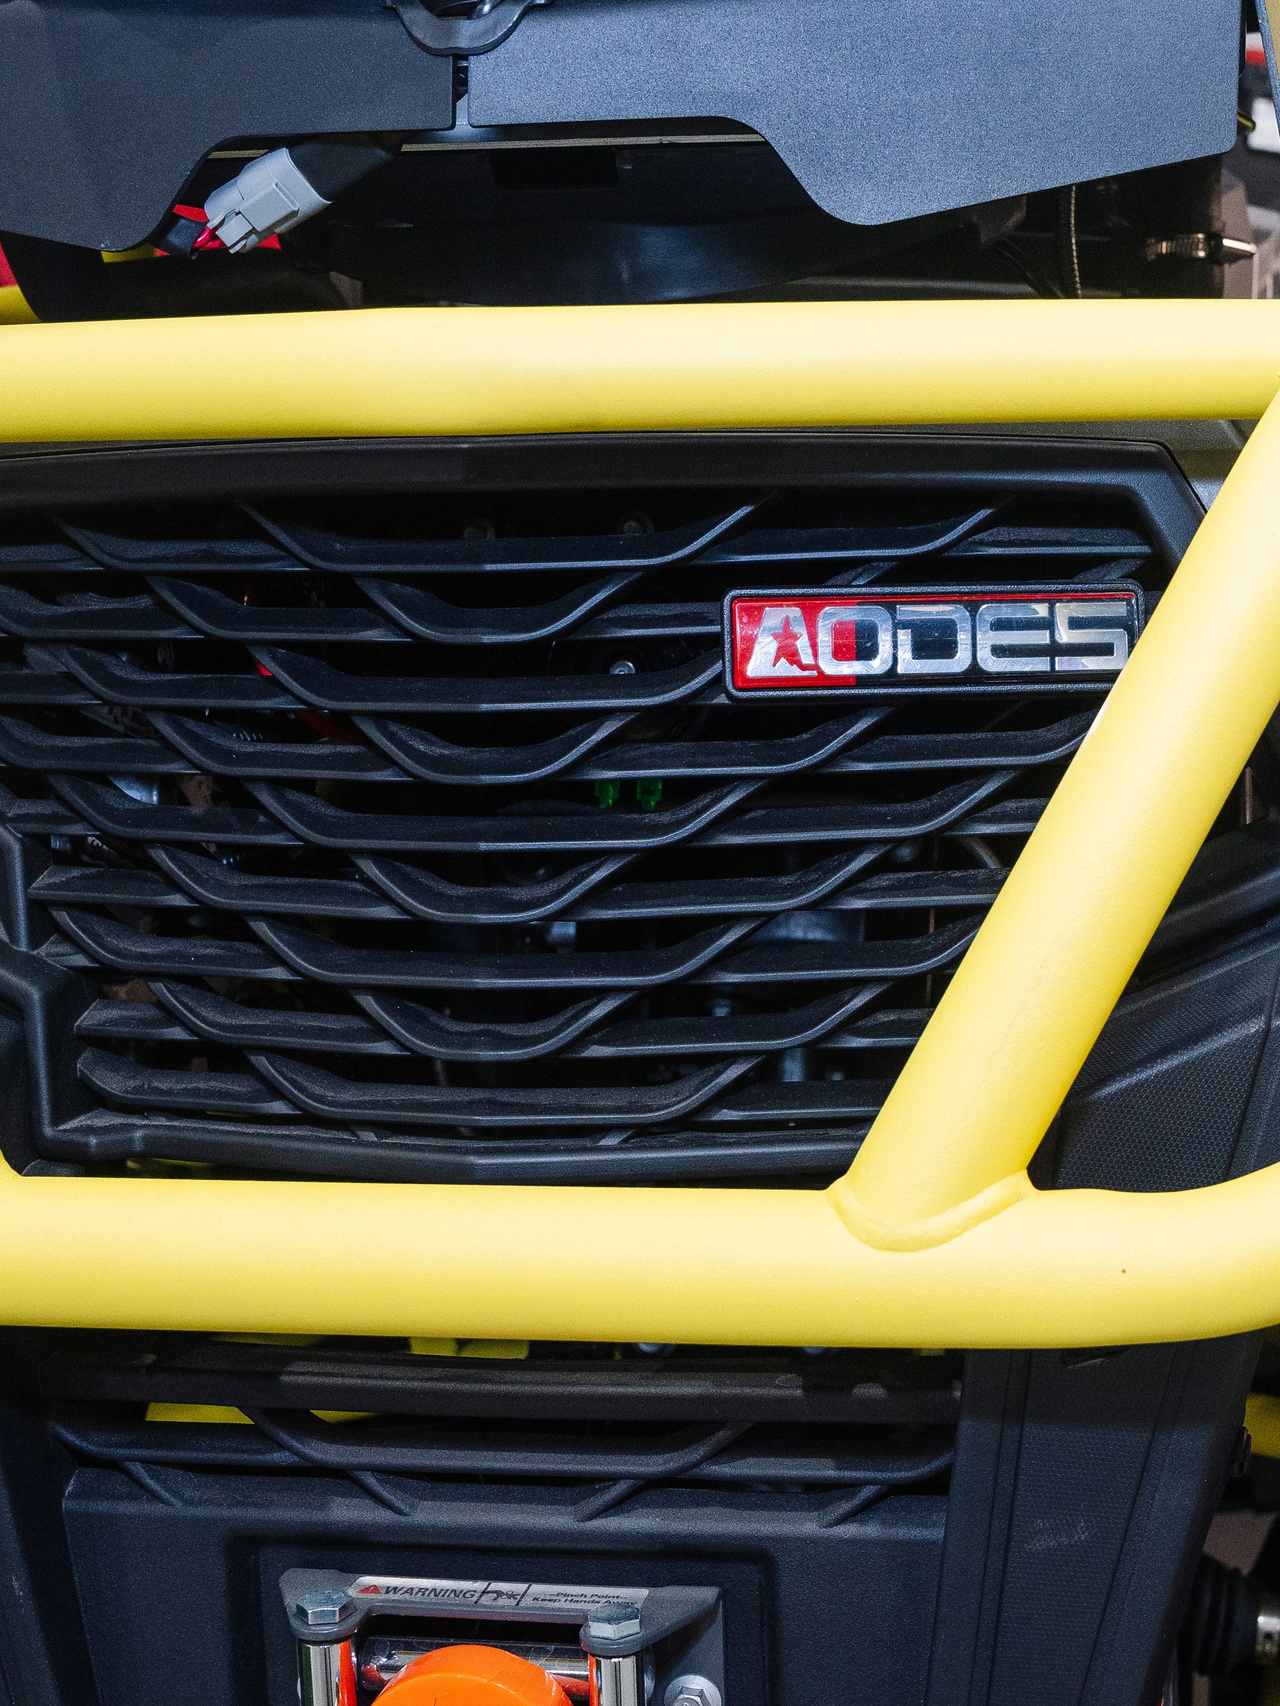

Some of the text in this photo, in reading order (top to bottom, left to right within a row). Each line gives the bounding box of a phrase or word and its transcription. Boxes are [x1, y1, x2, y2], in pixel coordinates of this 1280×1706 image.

[746, 602, 1128, 678] AODES
[384, 1585, 478, 1599] WARNING
[532, 1596, 561, 1604] Keep
